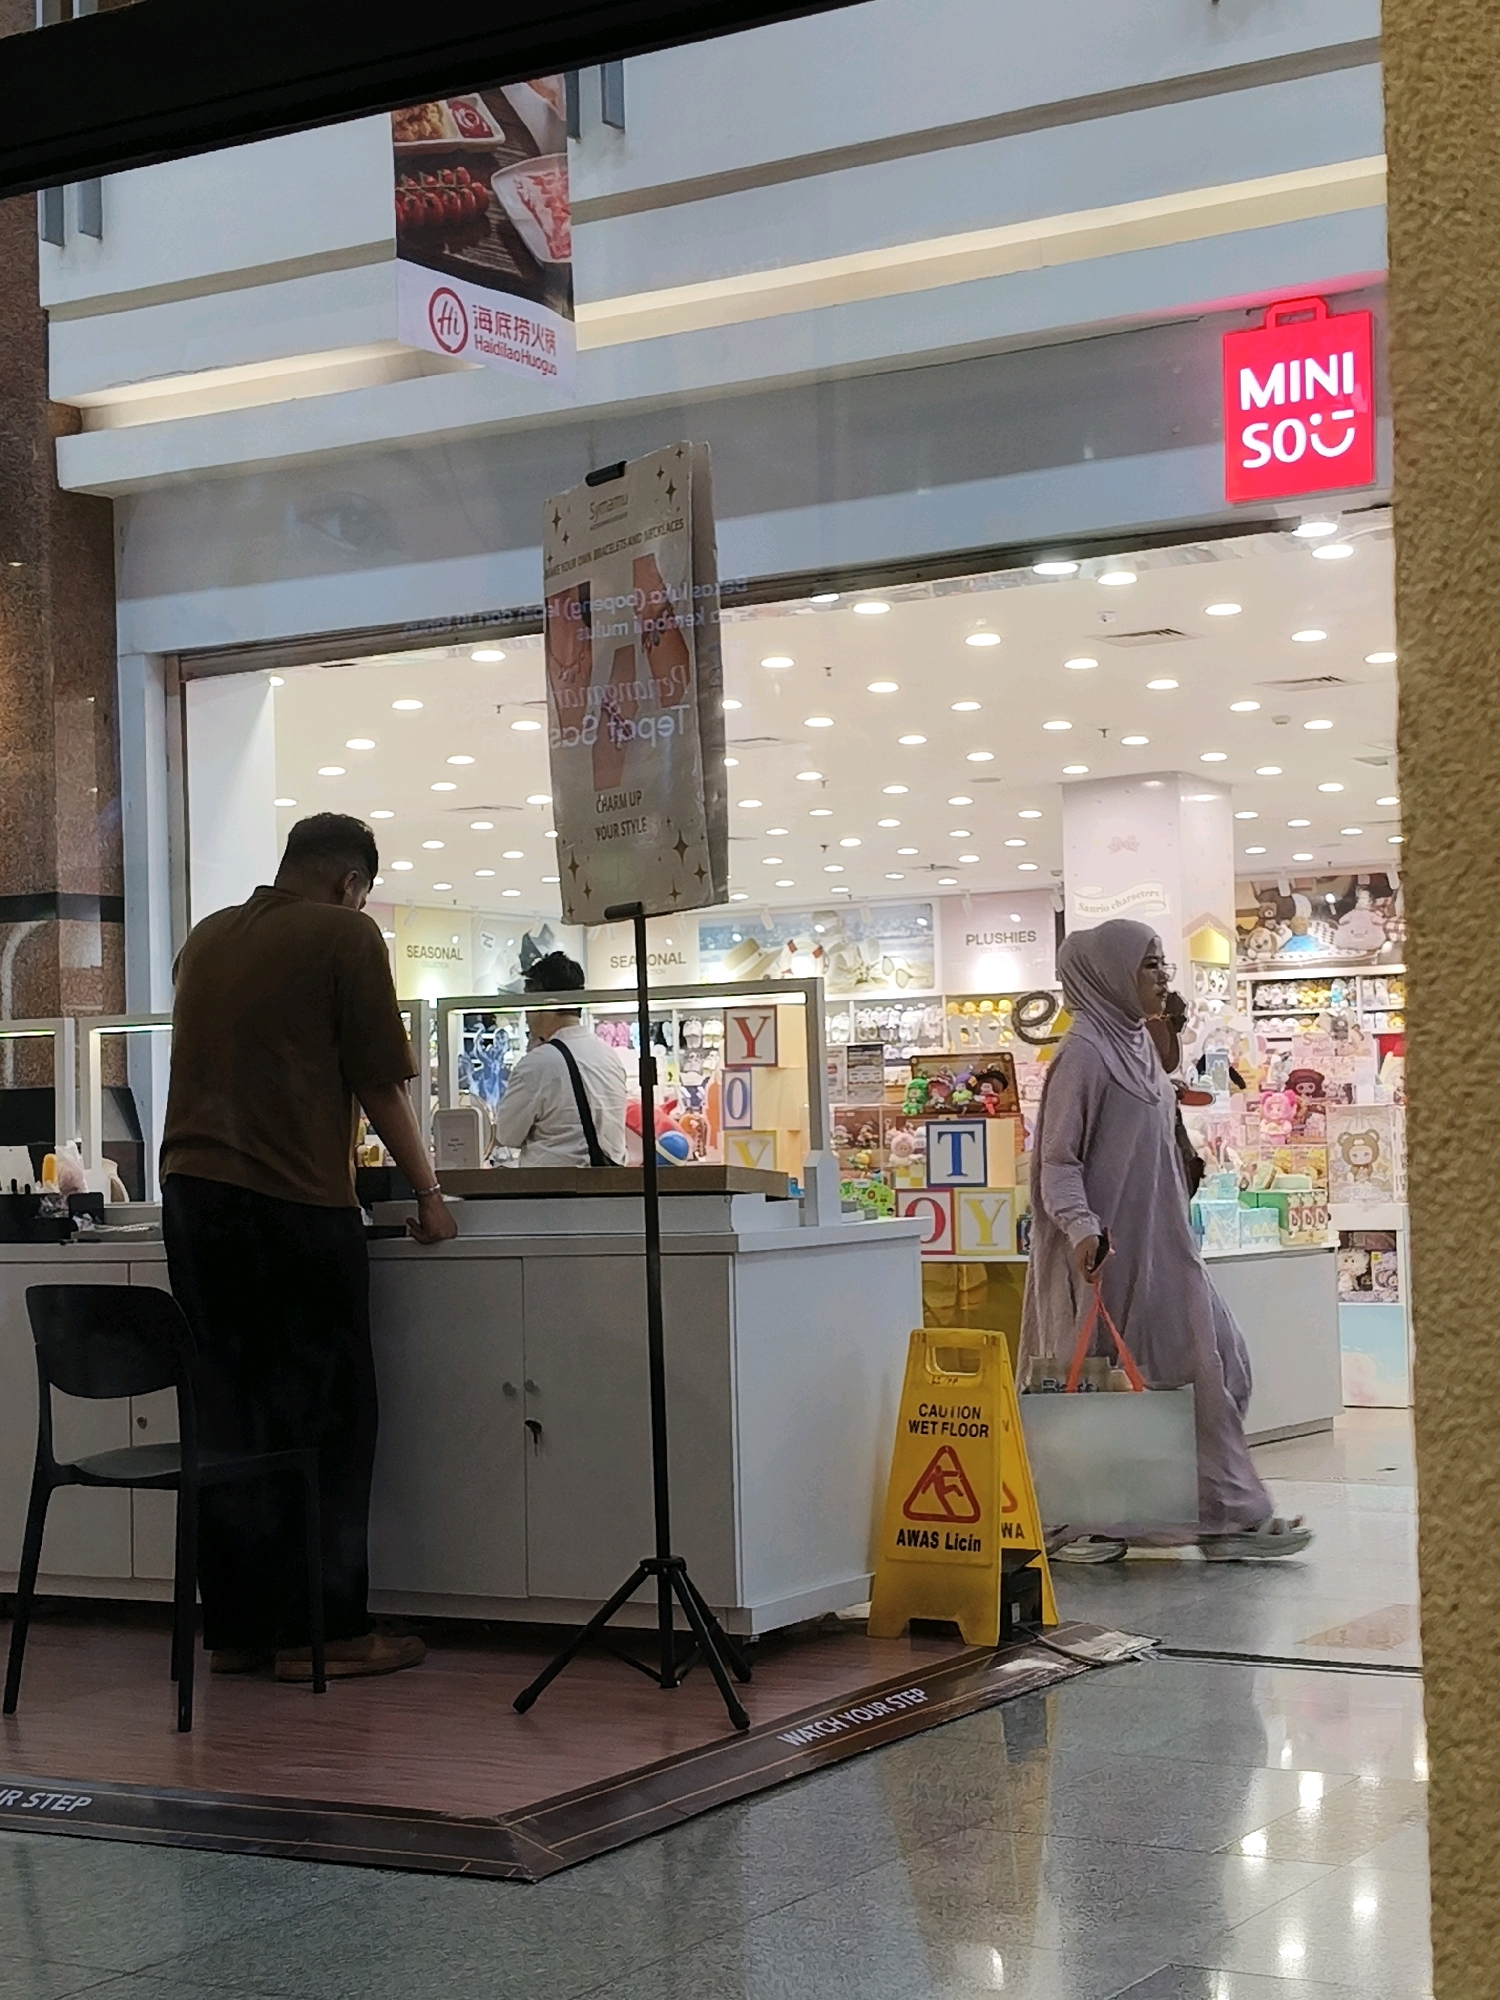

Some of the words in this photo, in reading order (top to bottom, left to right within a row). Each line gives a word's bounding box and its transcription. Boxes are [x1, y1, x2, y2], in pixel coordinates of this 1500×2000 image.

[438, 299, 460, 337] Hi
[1239, 351, 1355, 411] MINI
[593, 538, 627, 561] BRACELETS
[627, 532, 644, 549] AND
[644, 518, 685, 543] NECKLACES
[596, 793, 628, 814] CHARM
[628, 789, 644, 808] UP
[594, 823, 620, 842] YOUR
[620, 815, 648, 838] STYLE
[1077, 902, 1110, 914] Sanrio
[1111, 889, 1160, 911] characters
[965, 930, 1037, 946] PLUSHIES
[406, 944, 463, 961] SEASONAL
[610, 952, 686, 969] SEAONAL
[732, 1015, 771, 1060] Y
[937, 1130, 976, 1178] T
[918, 1403, 982, 1420] CAUTION
[908, 1419, 939, 1436] WET
[940, 1421, 990, 1439] FLOOR
[896, 1528, 939, 1550] AWAS
[944, 1532, 982, 1554] Licin
[776, 1715, 850, 1748] WATCH
[842, 1699, 896, 1728] YOUR
[887, 1687, 930, 1711] STEP
[21, 1791, 94, 1813] STEP
